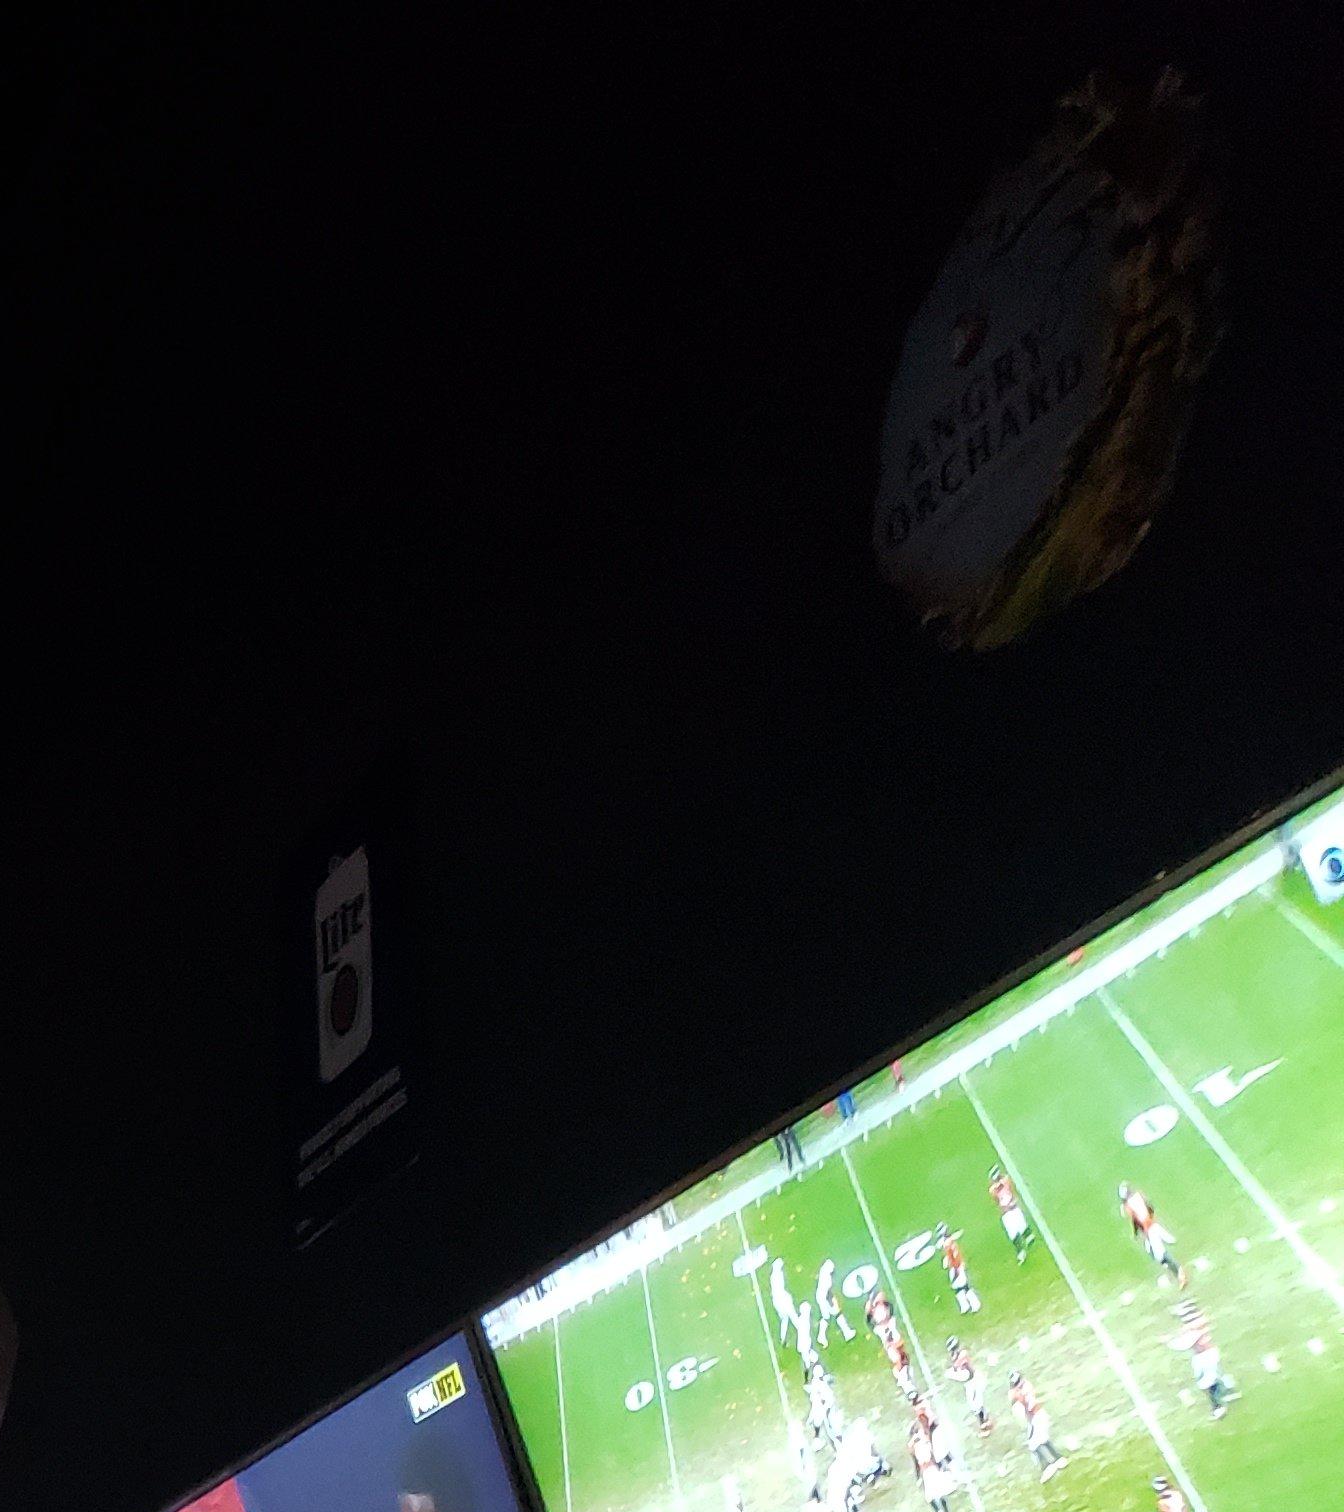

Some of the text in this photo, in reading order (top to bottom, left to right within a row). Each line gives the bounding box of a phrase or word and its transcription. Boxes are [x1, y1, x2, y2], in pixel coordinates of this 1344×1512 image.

[881, 352, 1082, 548] ORCHARD
[906, 322, 1058, 482] ANGRY
[320, 893, 364, 974] Lite
[436, 1370, 462, 1402] NFL
